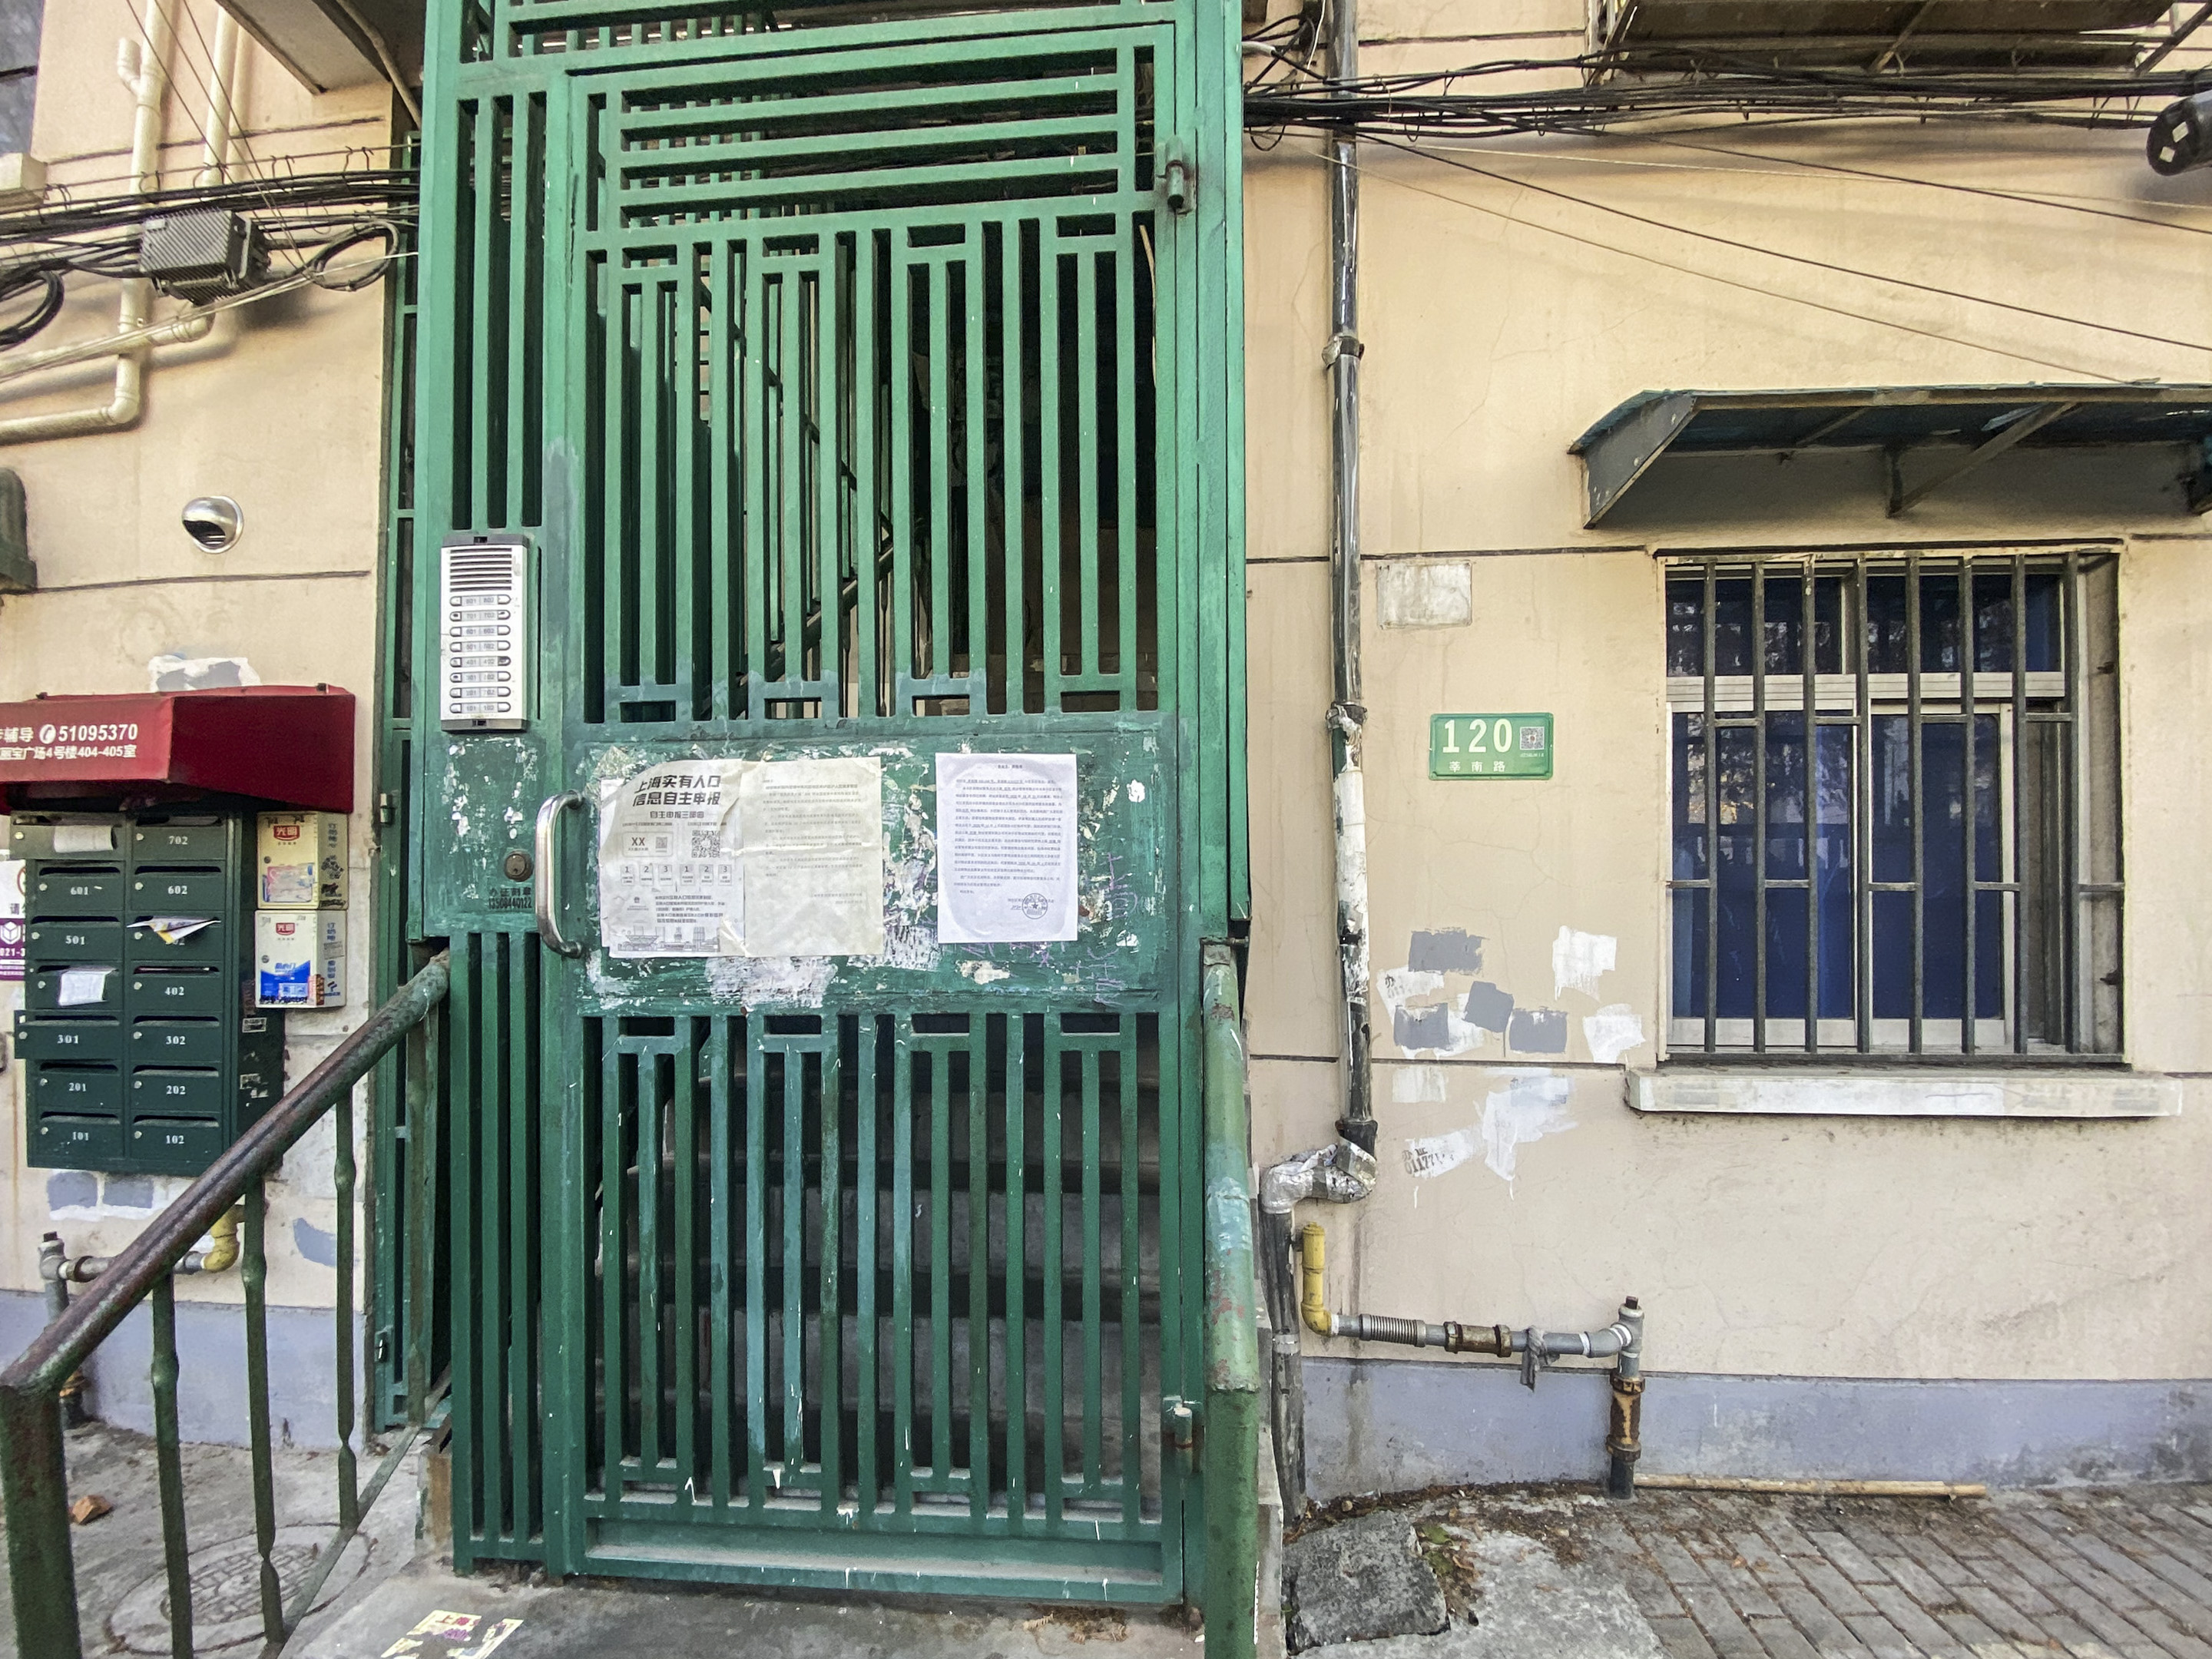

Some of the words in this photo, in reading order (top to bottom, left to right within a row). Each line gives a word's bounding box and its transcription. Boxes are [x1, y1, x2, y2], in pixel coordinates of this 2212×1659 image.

[0, 727, 34, 743] 辅导
[58, 724, 138, 741] 51095370
[1442, 719, 1512, 753] 120
[634, 775, 721, 794] 上海实有人口
[633, 791, 721, 806] 信息自主申报
[277, 826, 297, 836] 光明
[167, 836, 188, 845] 702
[71, 886, 88, 895] 601
[167, 886, 187, 895] 602
[65, 935, 85, 945] 501
[164, 987, 184, 995] 402
[57, 1035, 79, 1044] 301
[166, 1036, 186, 1045] 302
[68, 1082, 87, 1092] 201
[166, 1085, 186, 1095] 202
[72, 1131, 89, 1141] 101
[166, 1135, 184, 1144] 102
